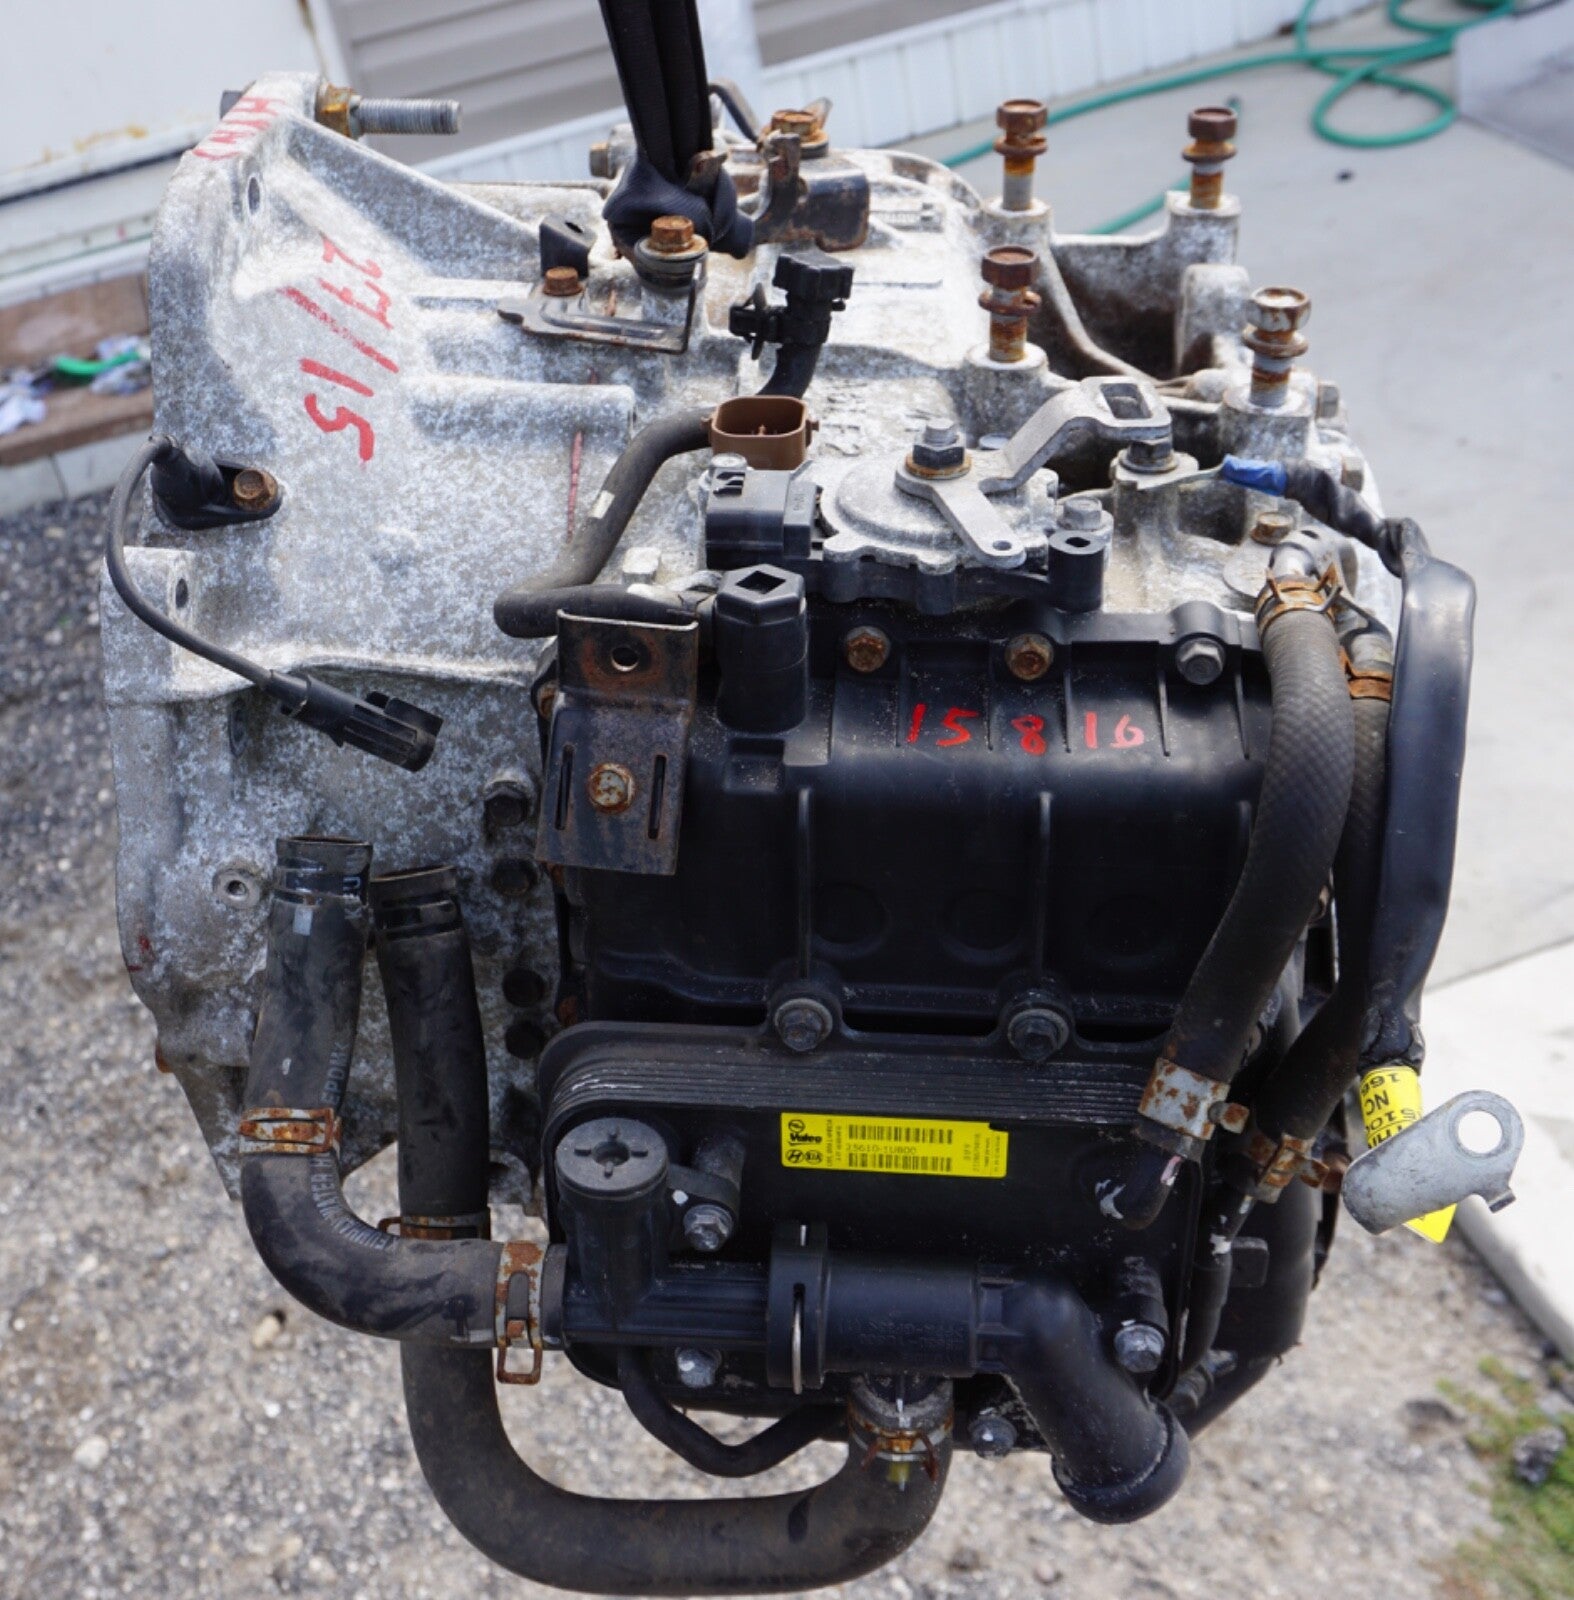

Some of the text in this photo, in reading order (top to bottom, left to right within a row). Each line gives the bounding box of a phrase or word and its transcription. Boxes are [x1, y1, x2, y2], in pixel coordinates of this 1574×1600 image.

[905, 703, 1145, 756] 15 8 16
[789, 1132, 822, 1144] Valeo
